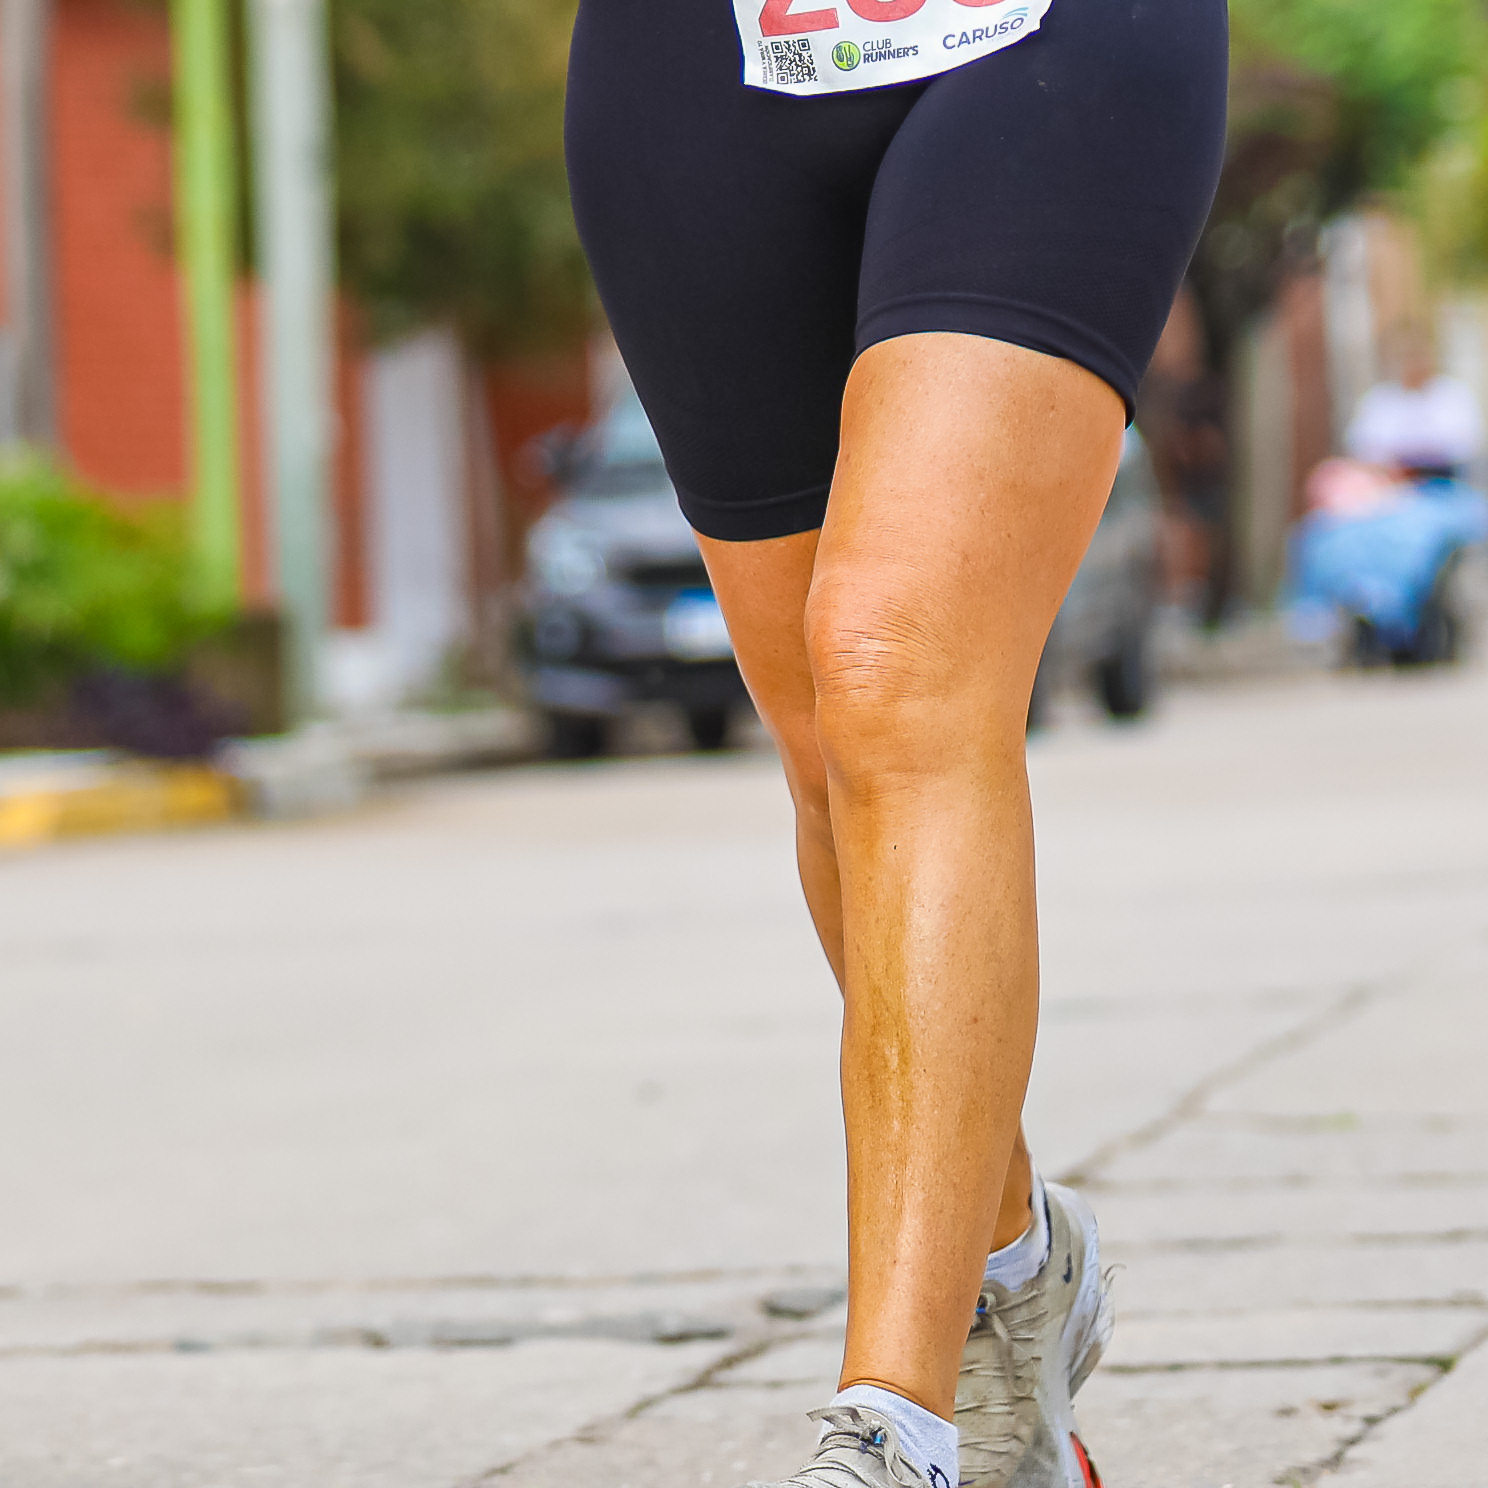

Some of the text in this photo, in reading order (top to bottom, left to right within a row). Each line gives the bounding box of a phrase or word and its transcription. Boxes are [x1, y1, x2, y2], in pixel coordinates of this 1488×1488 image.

[942, 17, 1025, 49] CARUSO
[862, 38, 892, 52] CLUB
[863, 45, 919, 64] RUNNER'S
